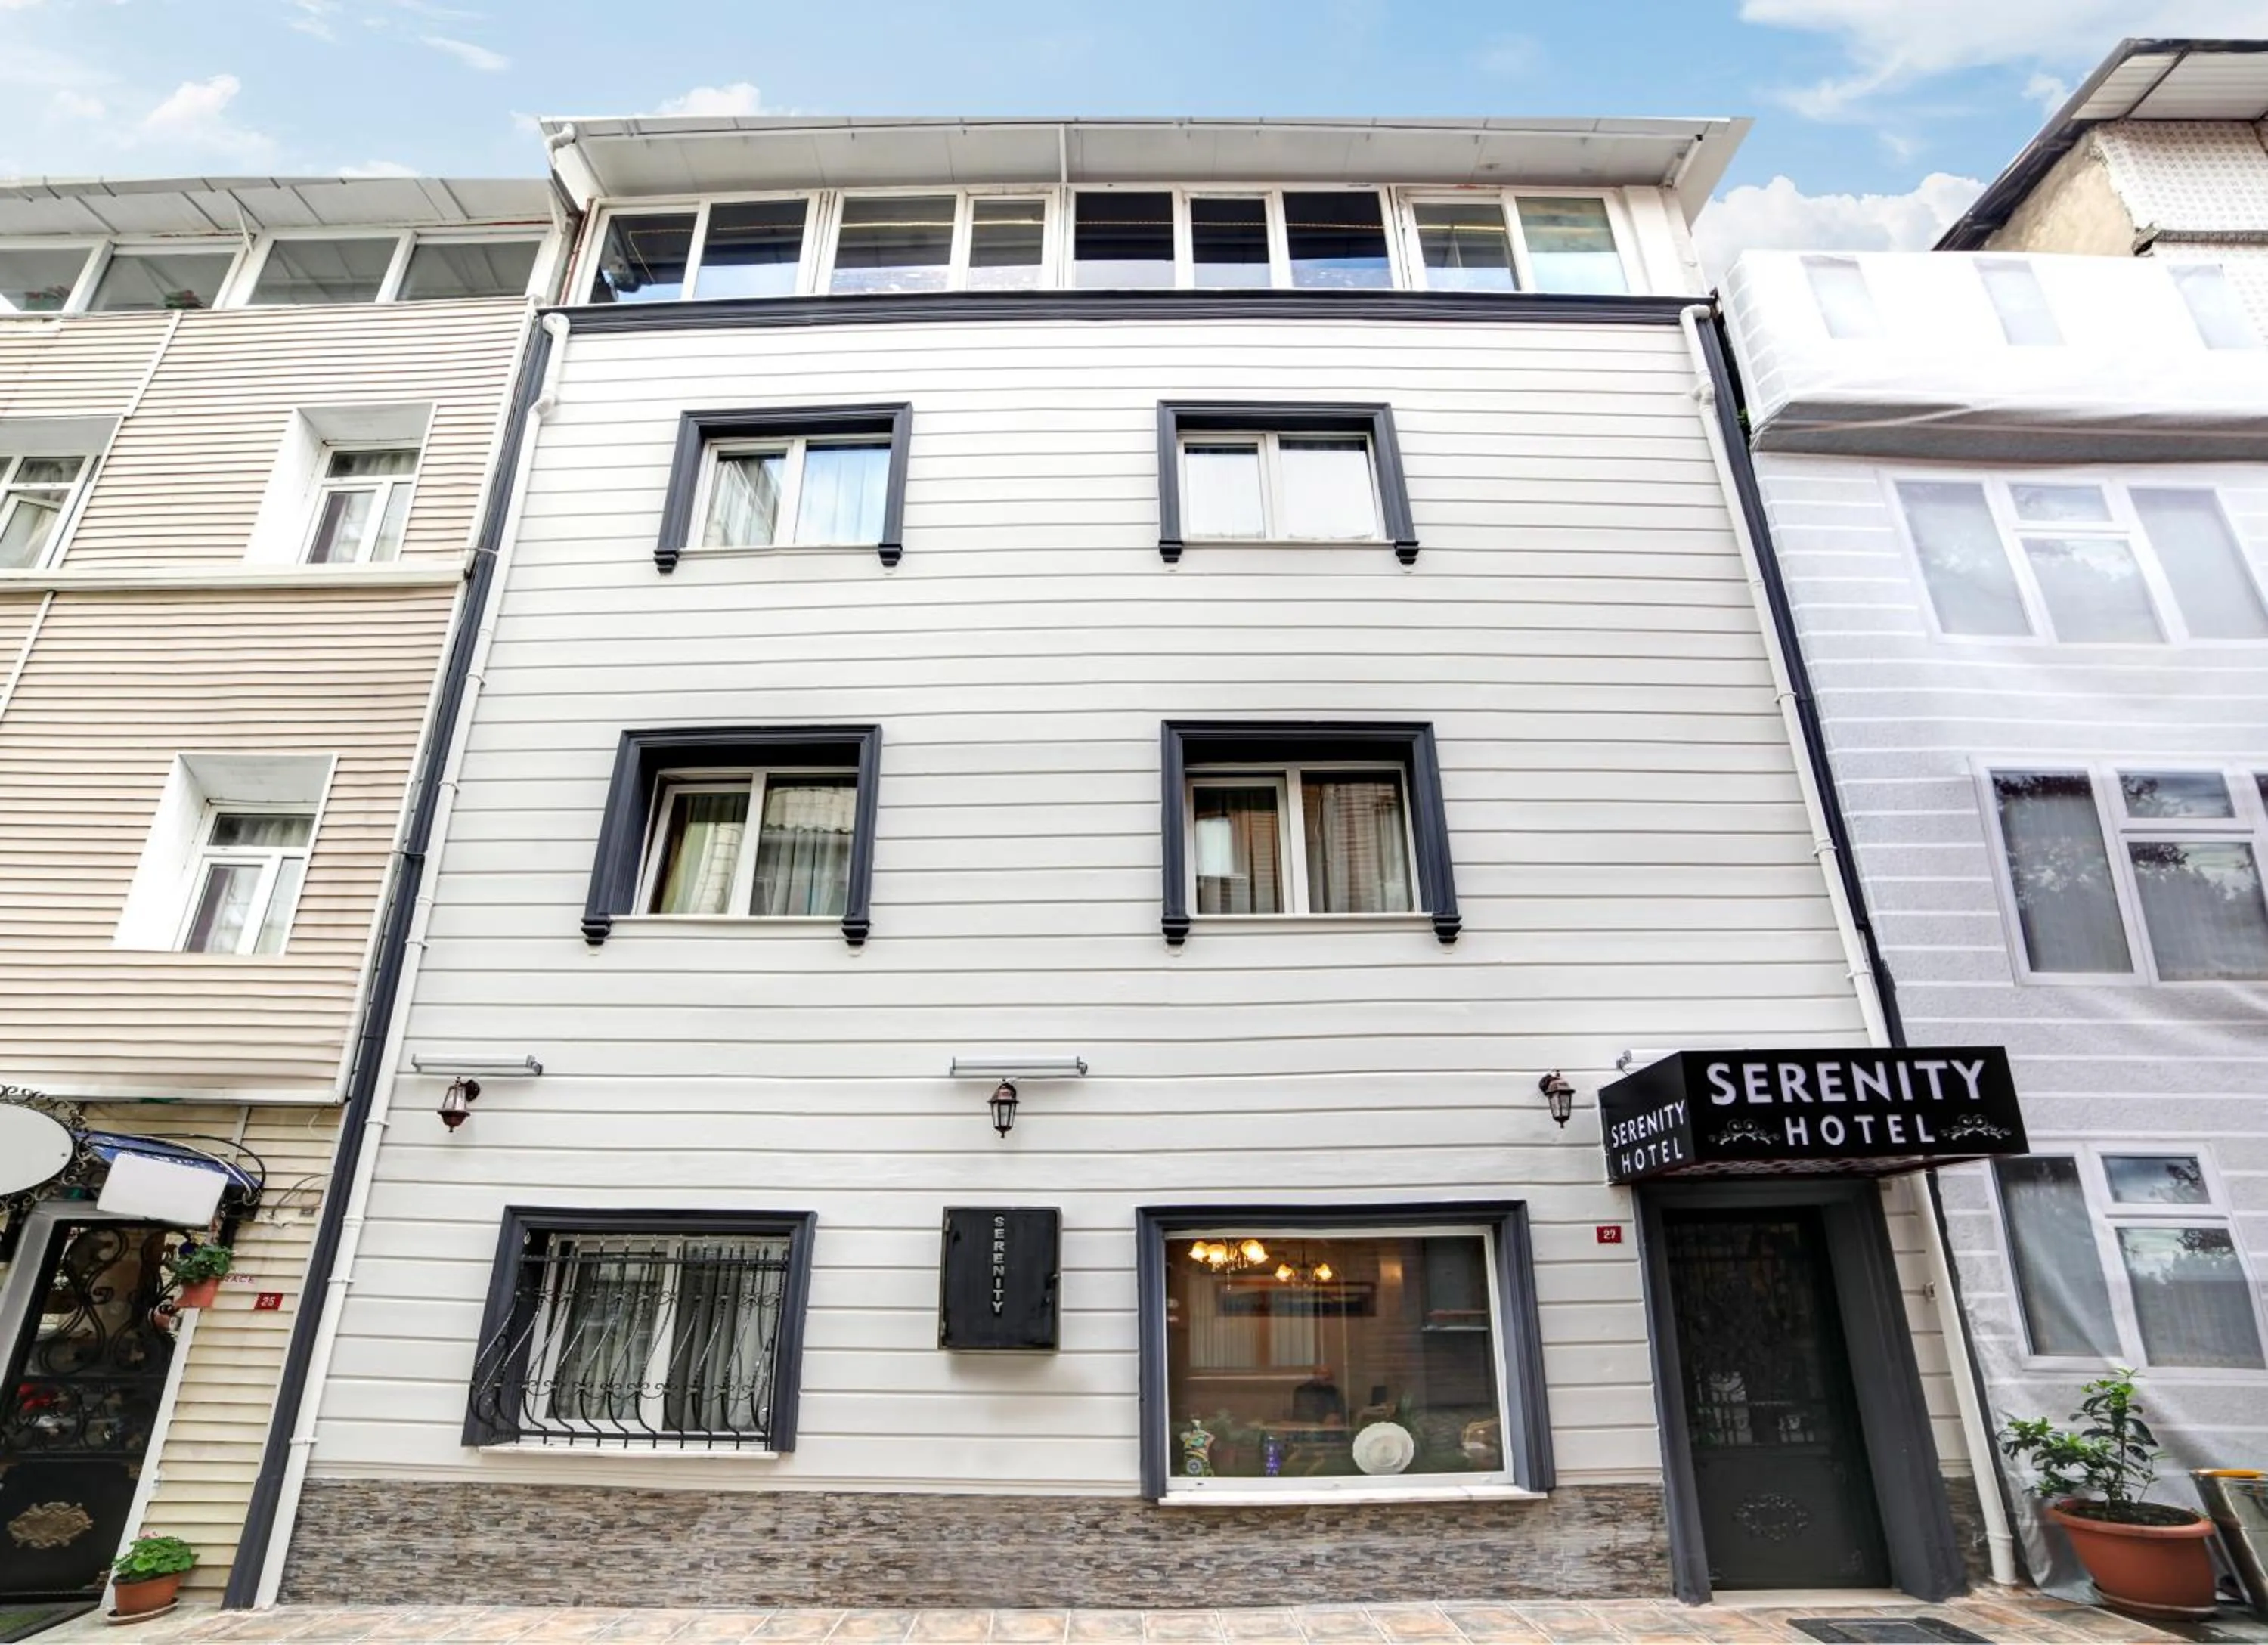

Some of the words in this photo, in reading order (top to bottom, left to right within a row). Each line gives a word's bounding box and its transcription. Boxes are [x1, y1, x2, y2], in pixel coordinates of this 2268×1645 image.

[1706, 1060, 1984, 1106] SERENITY
[1611, 1098, 1685, 1148] SERENITY
[1784, 1114, 1935, 1146] HOTEL
[1621, 1136, 1684, 1174] HOTEL
[1603, 1228, 1616, 1240] 27
[991, 1216, 1005, 1314] SERENITY
[260, 1296, 276, 1307] 25
